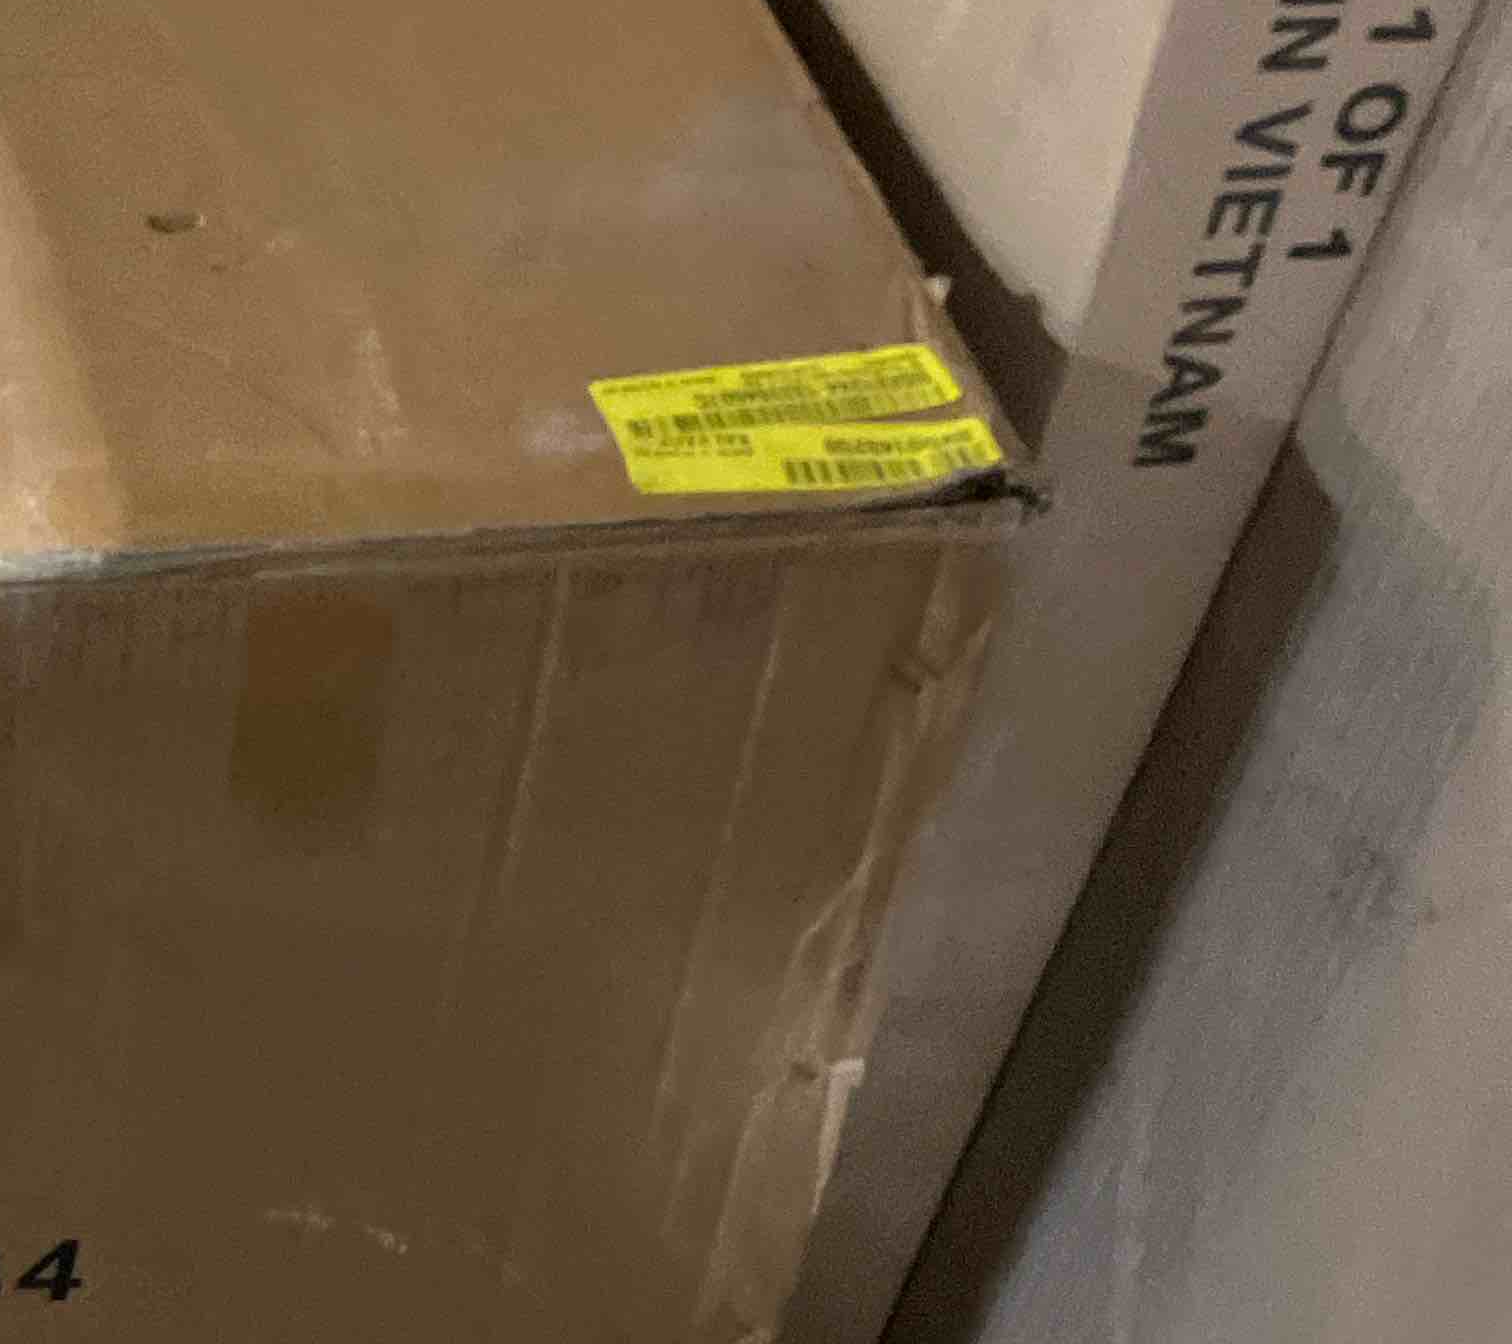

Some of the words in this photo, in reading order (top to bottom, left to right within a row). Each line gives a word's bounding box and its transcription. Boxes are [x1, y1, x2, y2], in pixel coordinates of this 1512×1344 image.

[1367, 7, 1437, 41] 1
[1320, 82, 1409, 197] OF
[1287, 228, 1352, 257] 1
[1133, 100, 1314, 469] VIETNAM
